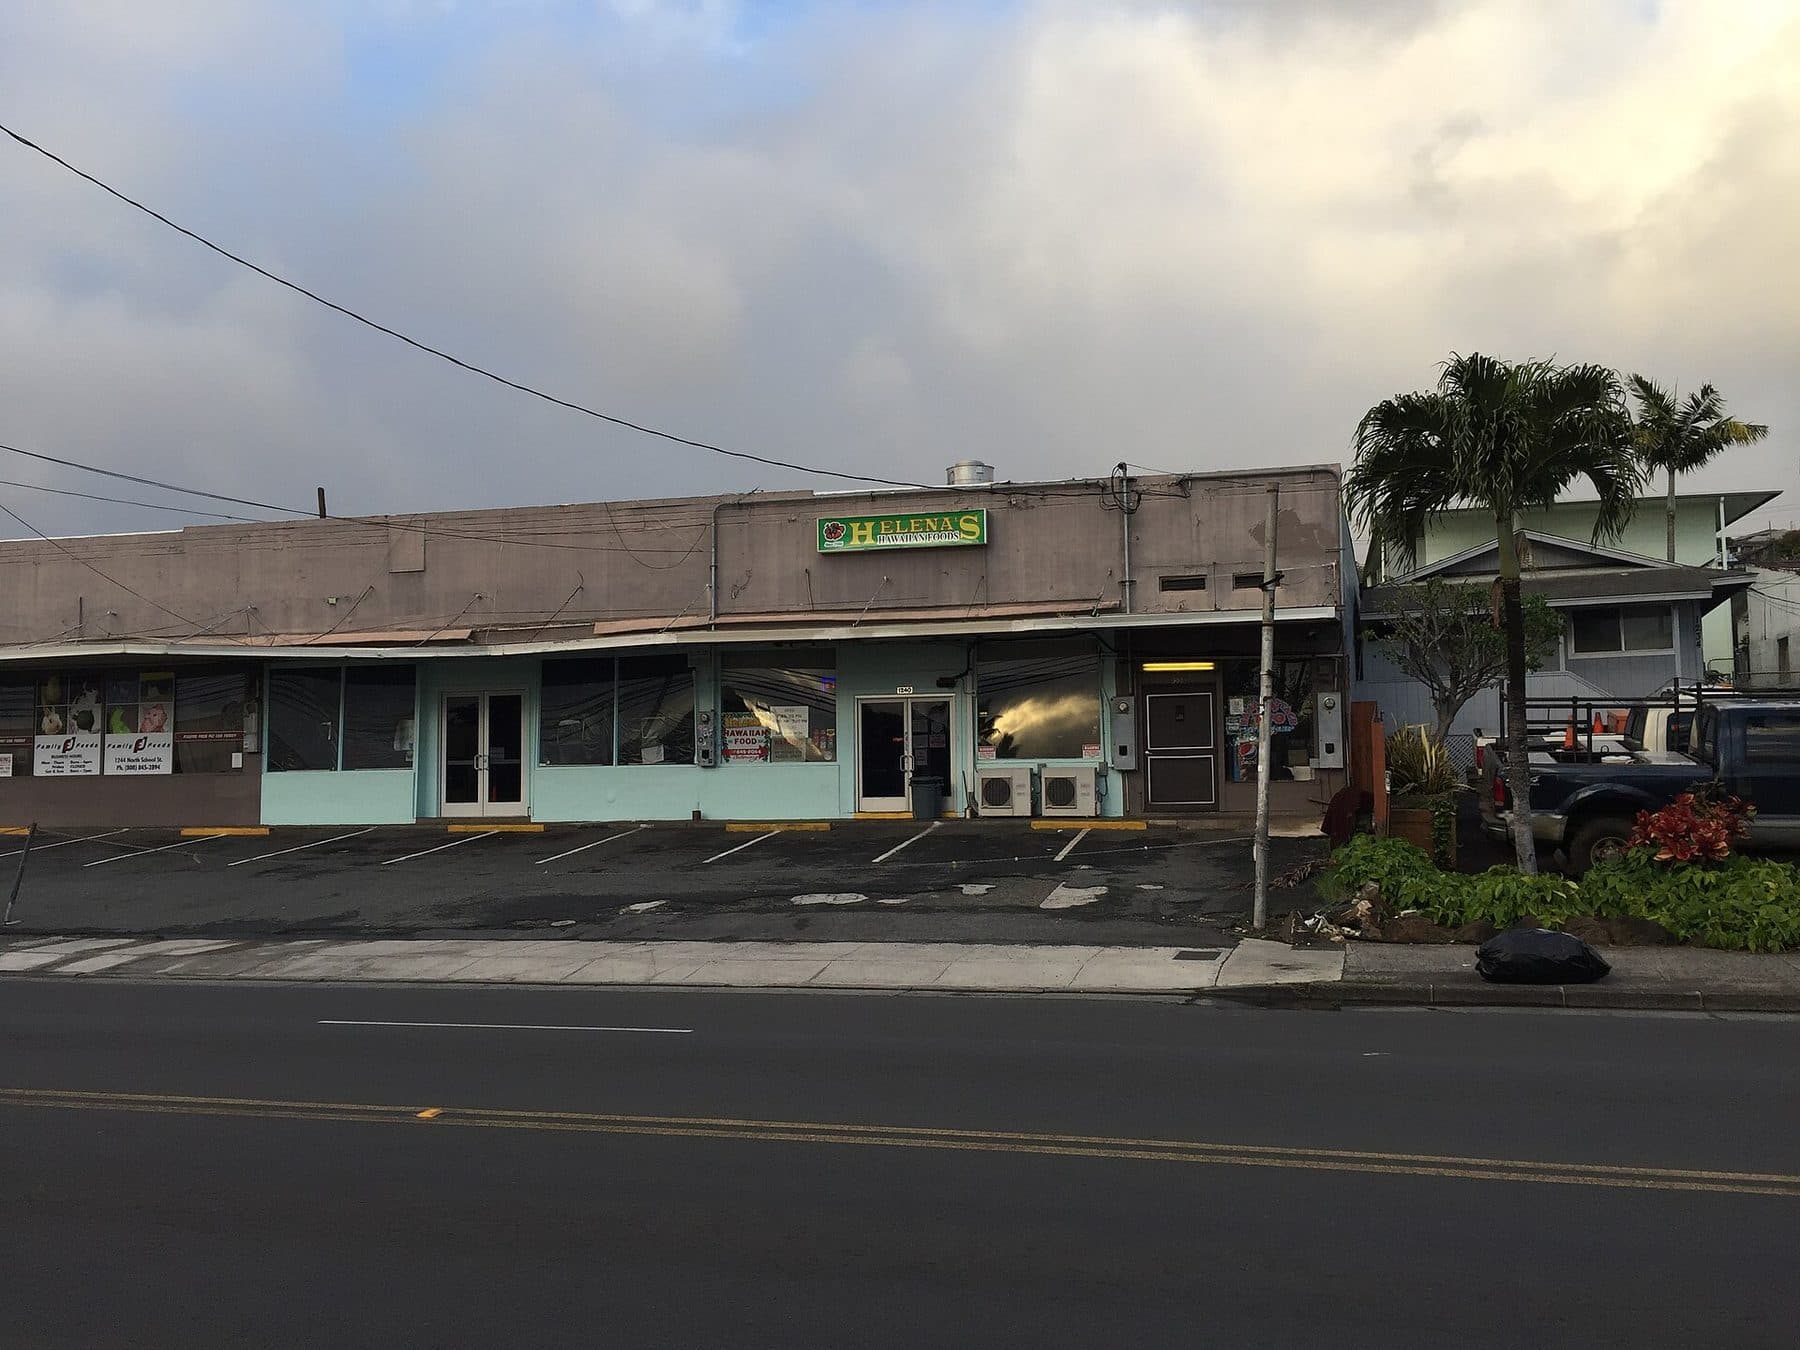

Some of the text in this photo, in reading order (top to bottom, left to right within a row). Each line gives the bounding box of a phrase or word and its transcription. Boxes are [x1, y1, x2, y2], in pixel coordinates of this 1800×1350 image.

[849, 514, 981, 546] HELENA'S
[877, 530, 960, 545] HAWAIIAN FOODS
[723, 729, 769, 737] HAWAIIAN
